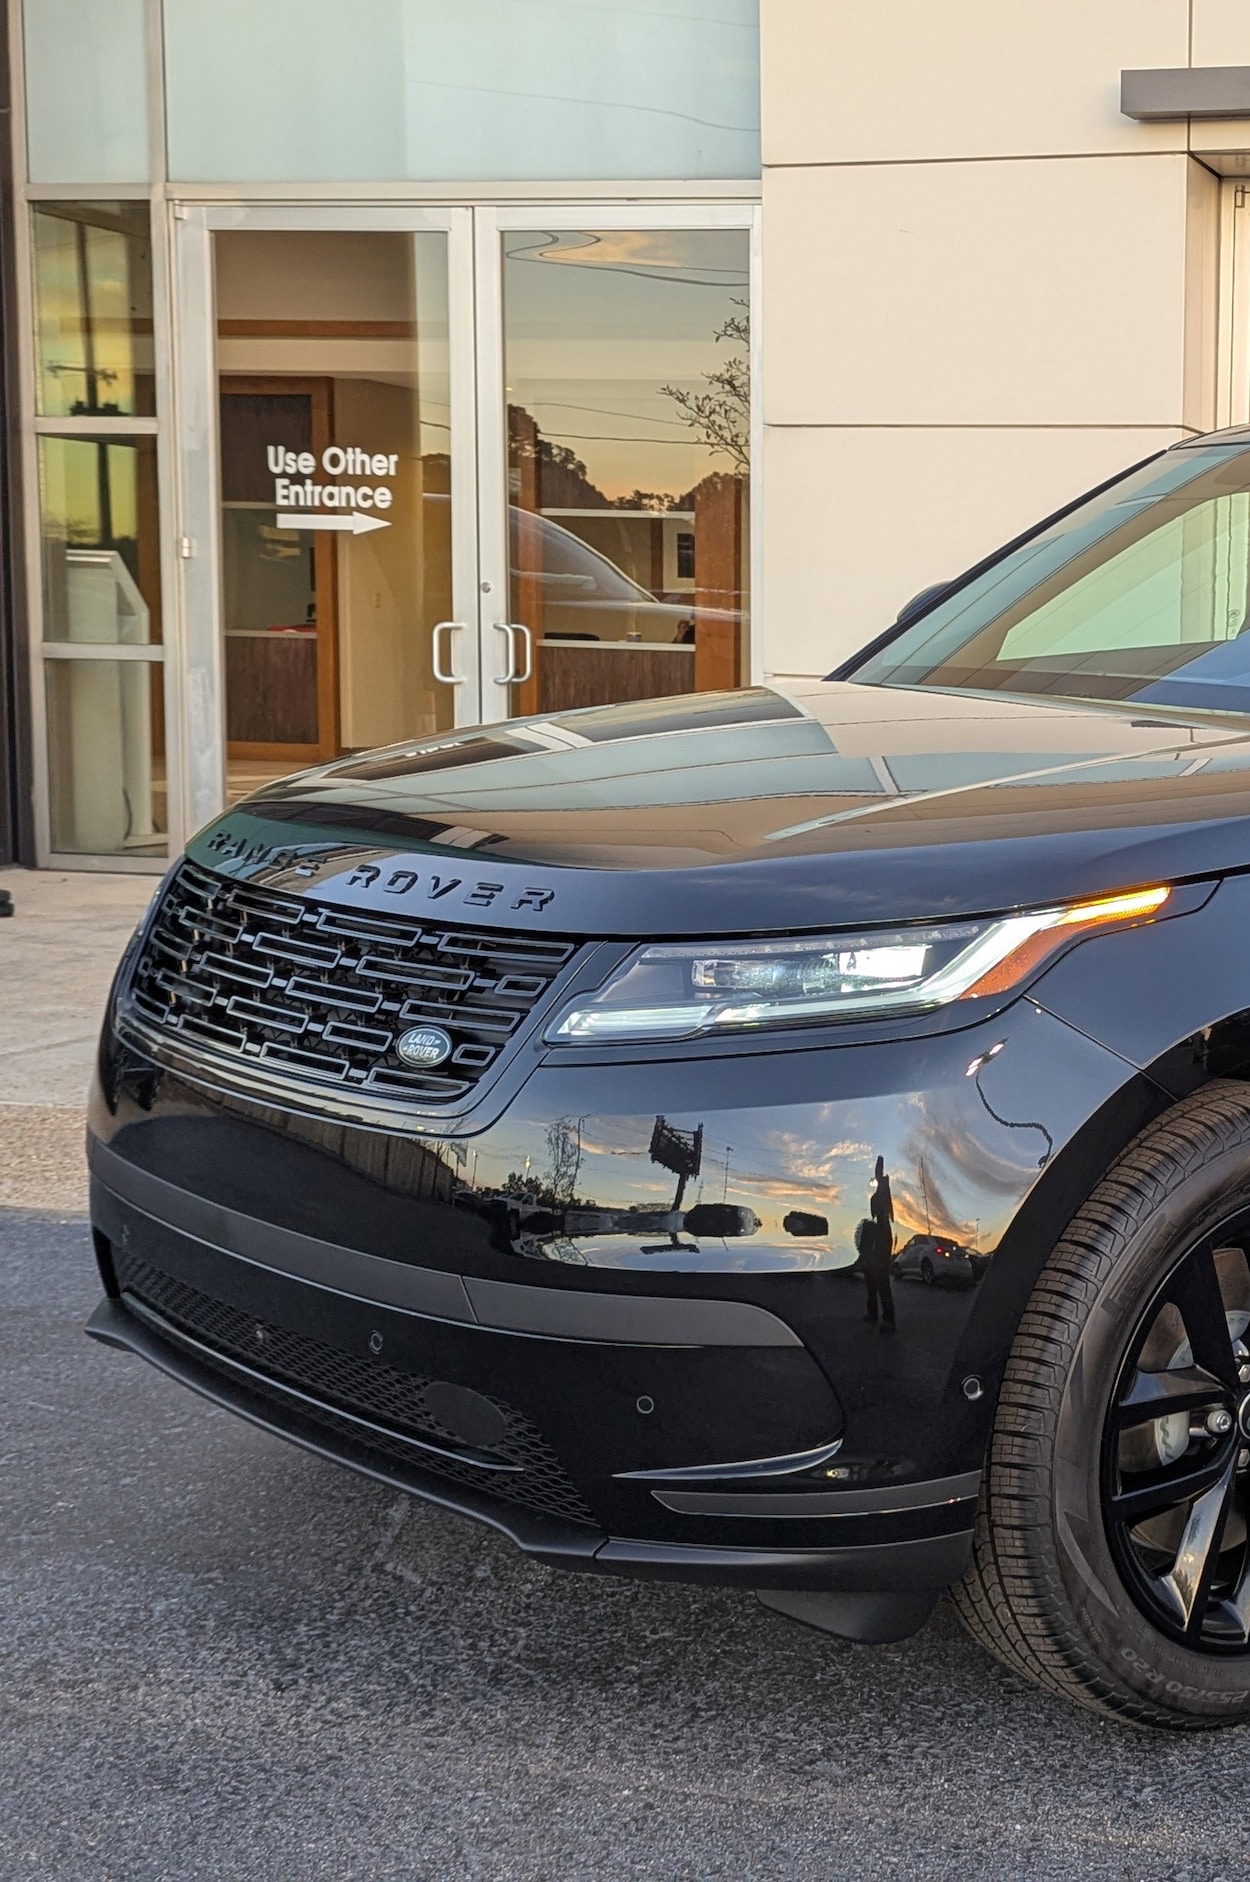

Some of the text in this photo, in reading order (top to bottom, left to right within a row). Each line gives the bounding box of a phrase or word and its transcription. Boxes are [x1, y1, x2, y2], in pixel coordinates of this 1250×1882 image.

[266, 445, 399, 477] Use Other
[275, 478, 393, 509] Entrance
[207, 830, 555, 912] RANGE ROVER
[406, 1044, 440, 1059] ROVER
[408, 1032, 437, 1046] LAND
